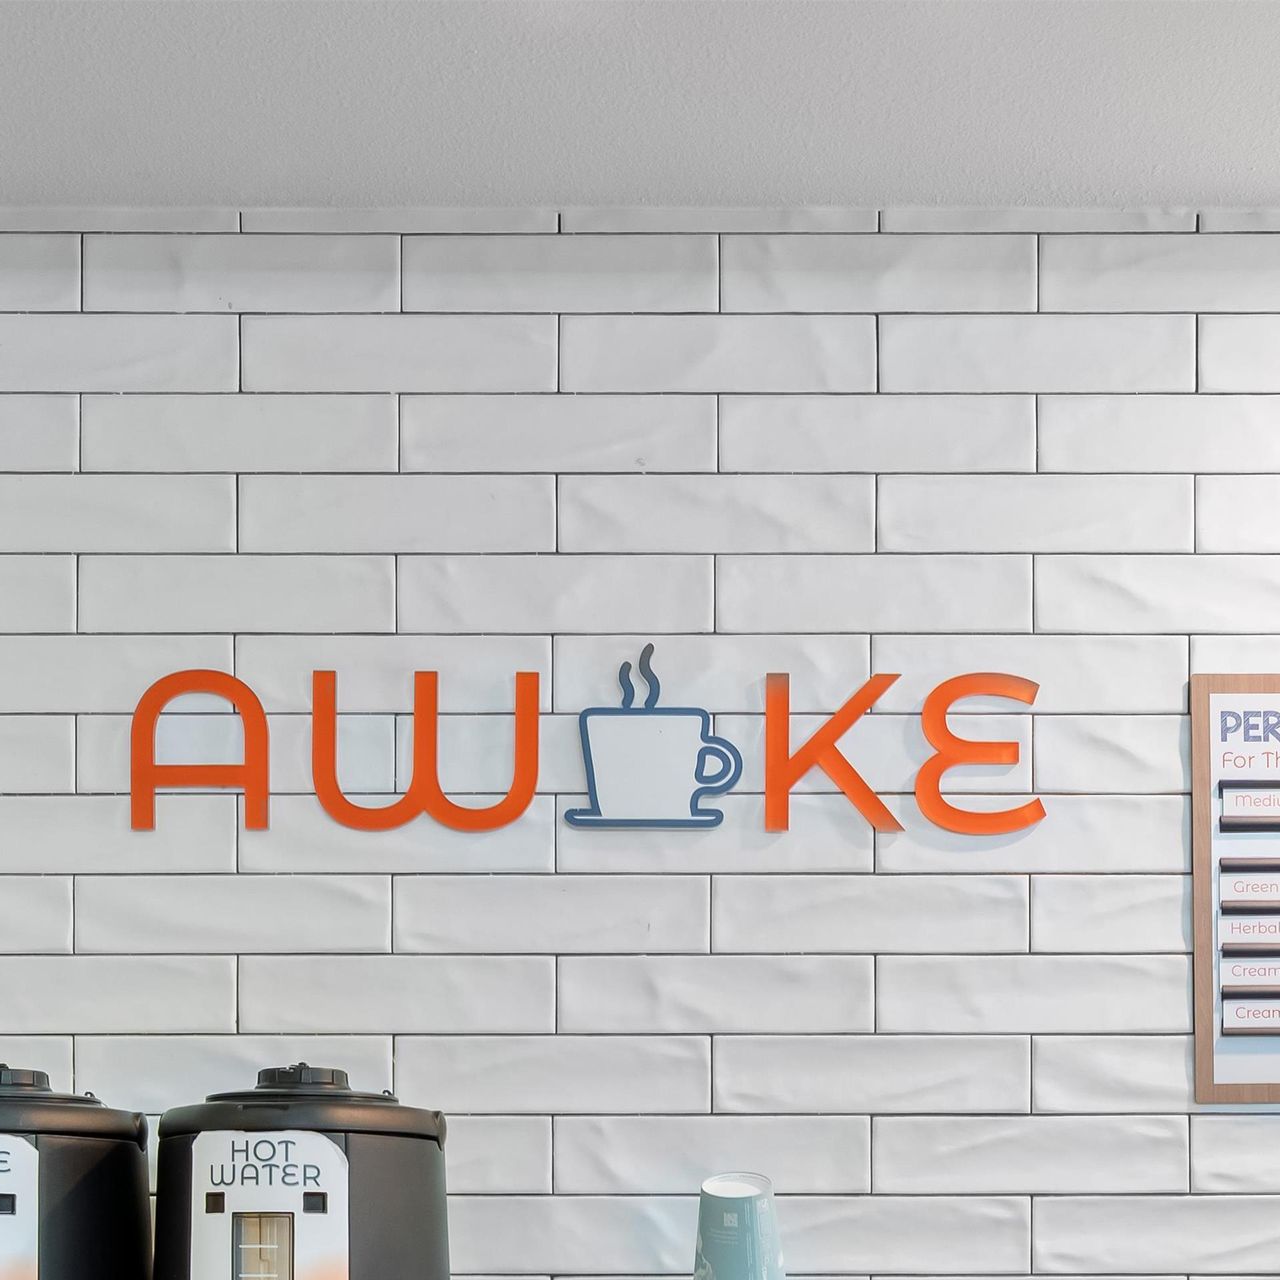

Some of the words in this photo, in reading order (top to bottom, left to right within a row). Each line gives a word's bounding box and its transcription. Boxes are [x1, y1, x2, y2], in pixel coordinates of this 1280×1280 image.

[1221, 751, 1255, 769] For
[1232, 880, 1278, 894] Green
[231, 1139, 296, 1162] HOT
[210, 1163, 321, 1187] WATER
